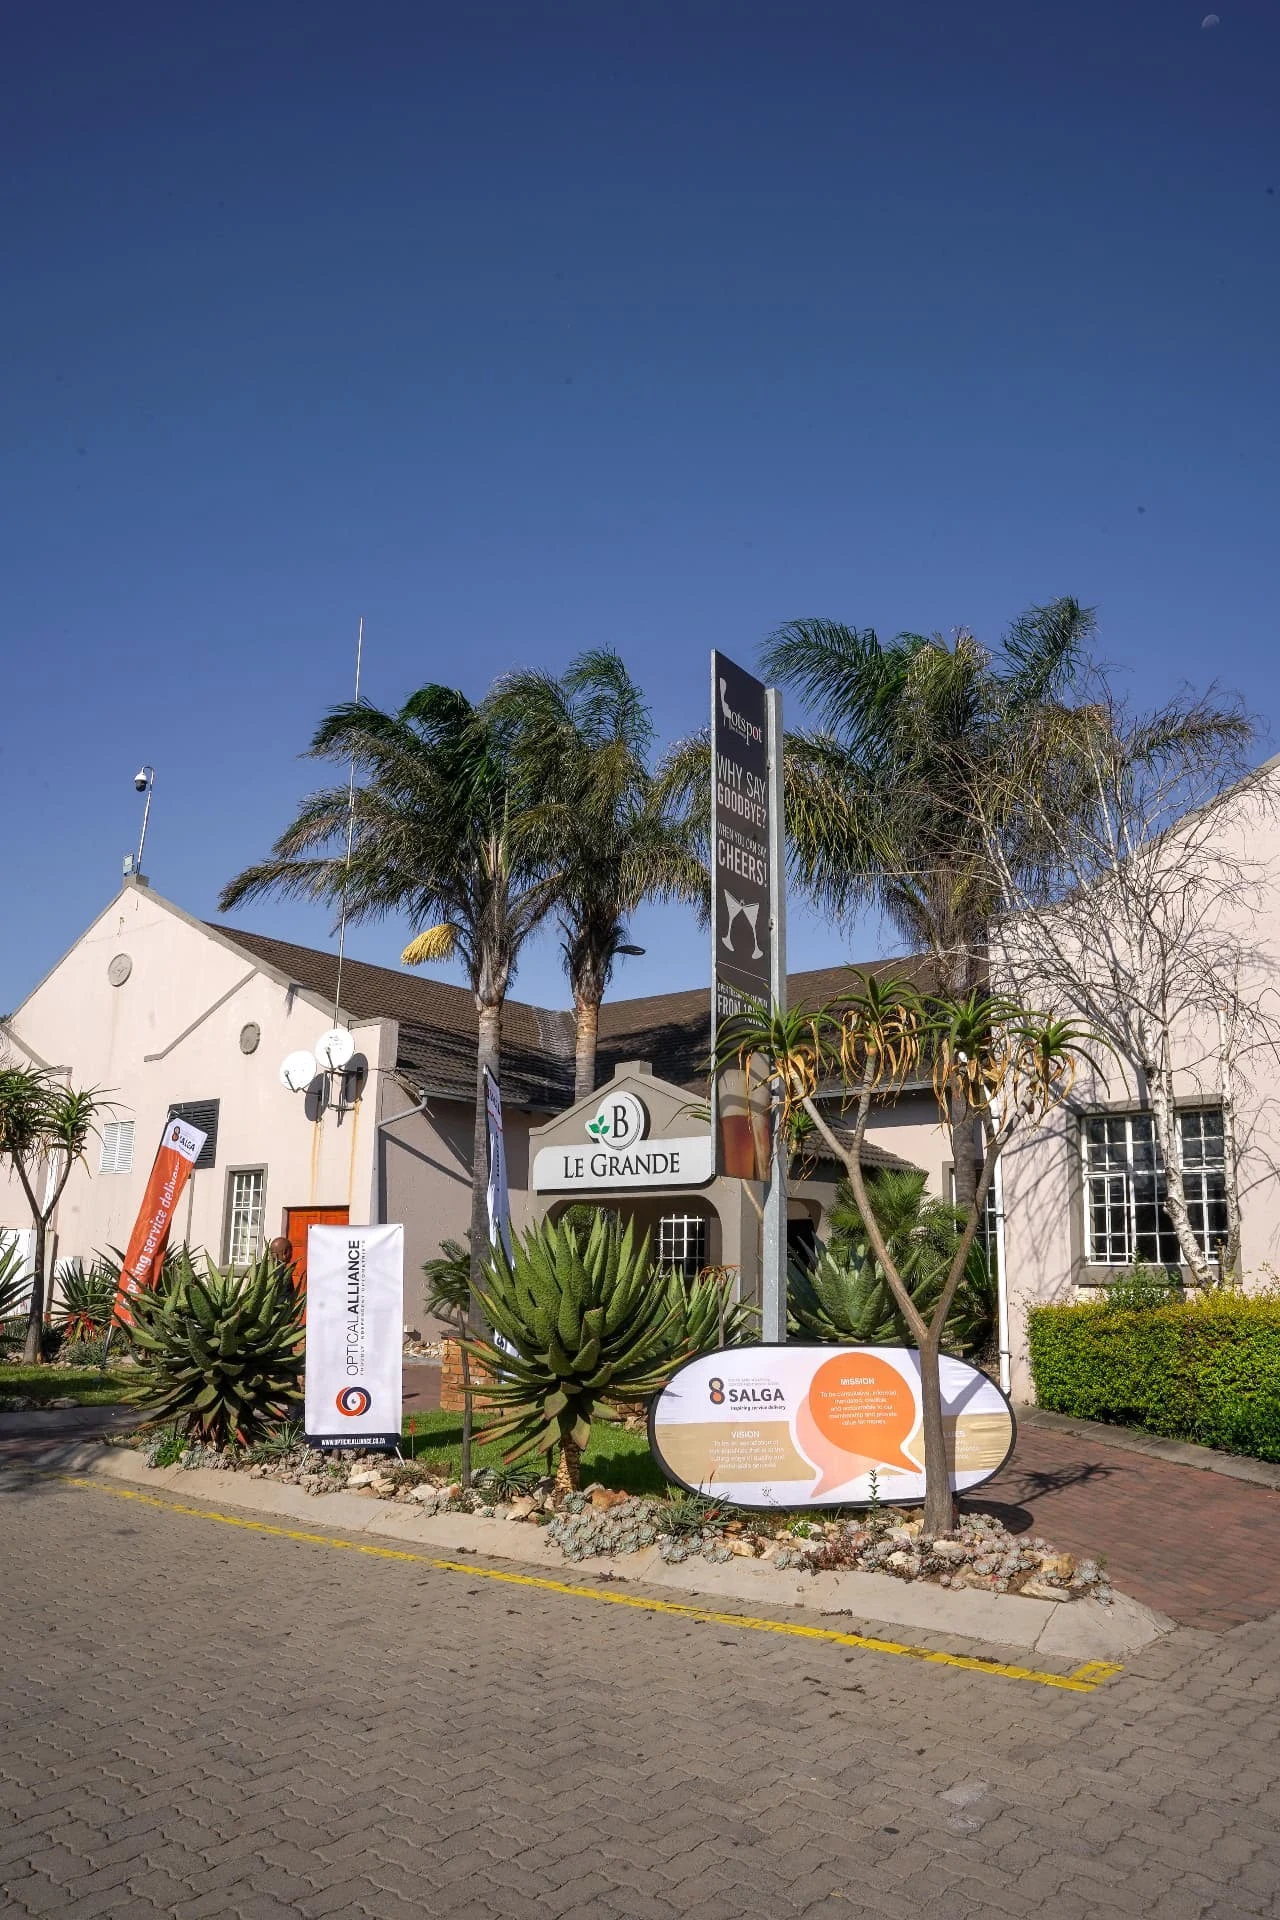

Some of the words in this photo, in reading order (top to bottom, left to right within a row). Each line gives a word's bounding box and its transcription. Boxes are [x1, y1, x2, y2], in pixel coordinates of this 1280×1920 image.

[717, 752, 743, 790] WHY
[746, 771, 766, 804] SAY
[717, 782, 767, 829] GOODBYE?
[718, 839, 767, 888] CHEERS!
[611, 1105, 629, 1138] B
[590, 1152, 680, 1177] GRANDE
[143, 1209, 168, 1254] service
[728, 1388, 785, 1402] SALGA
[840, 1377, 875, 1386] MISSION
